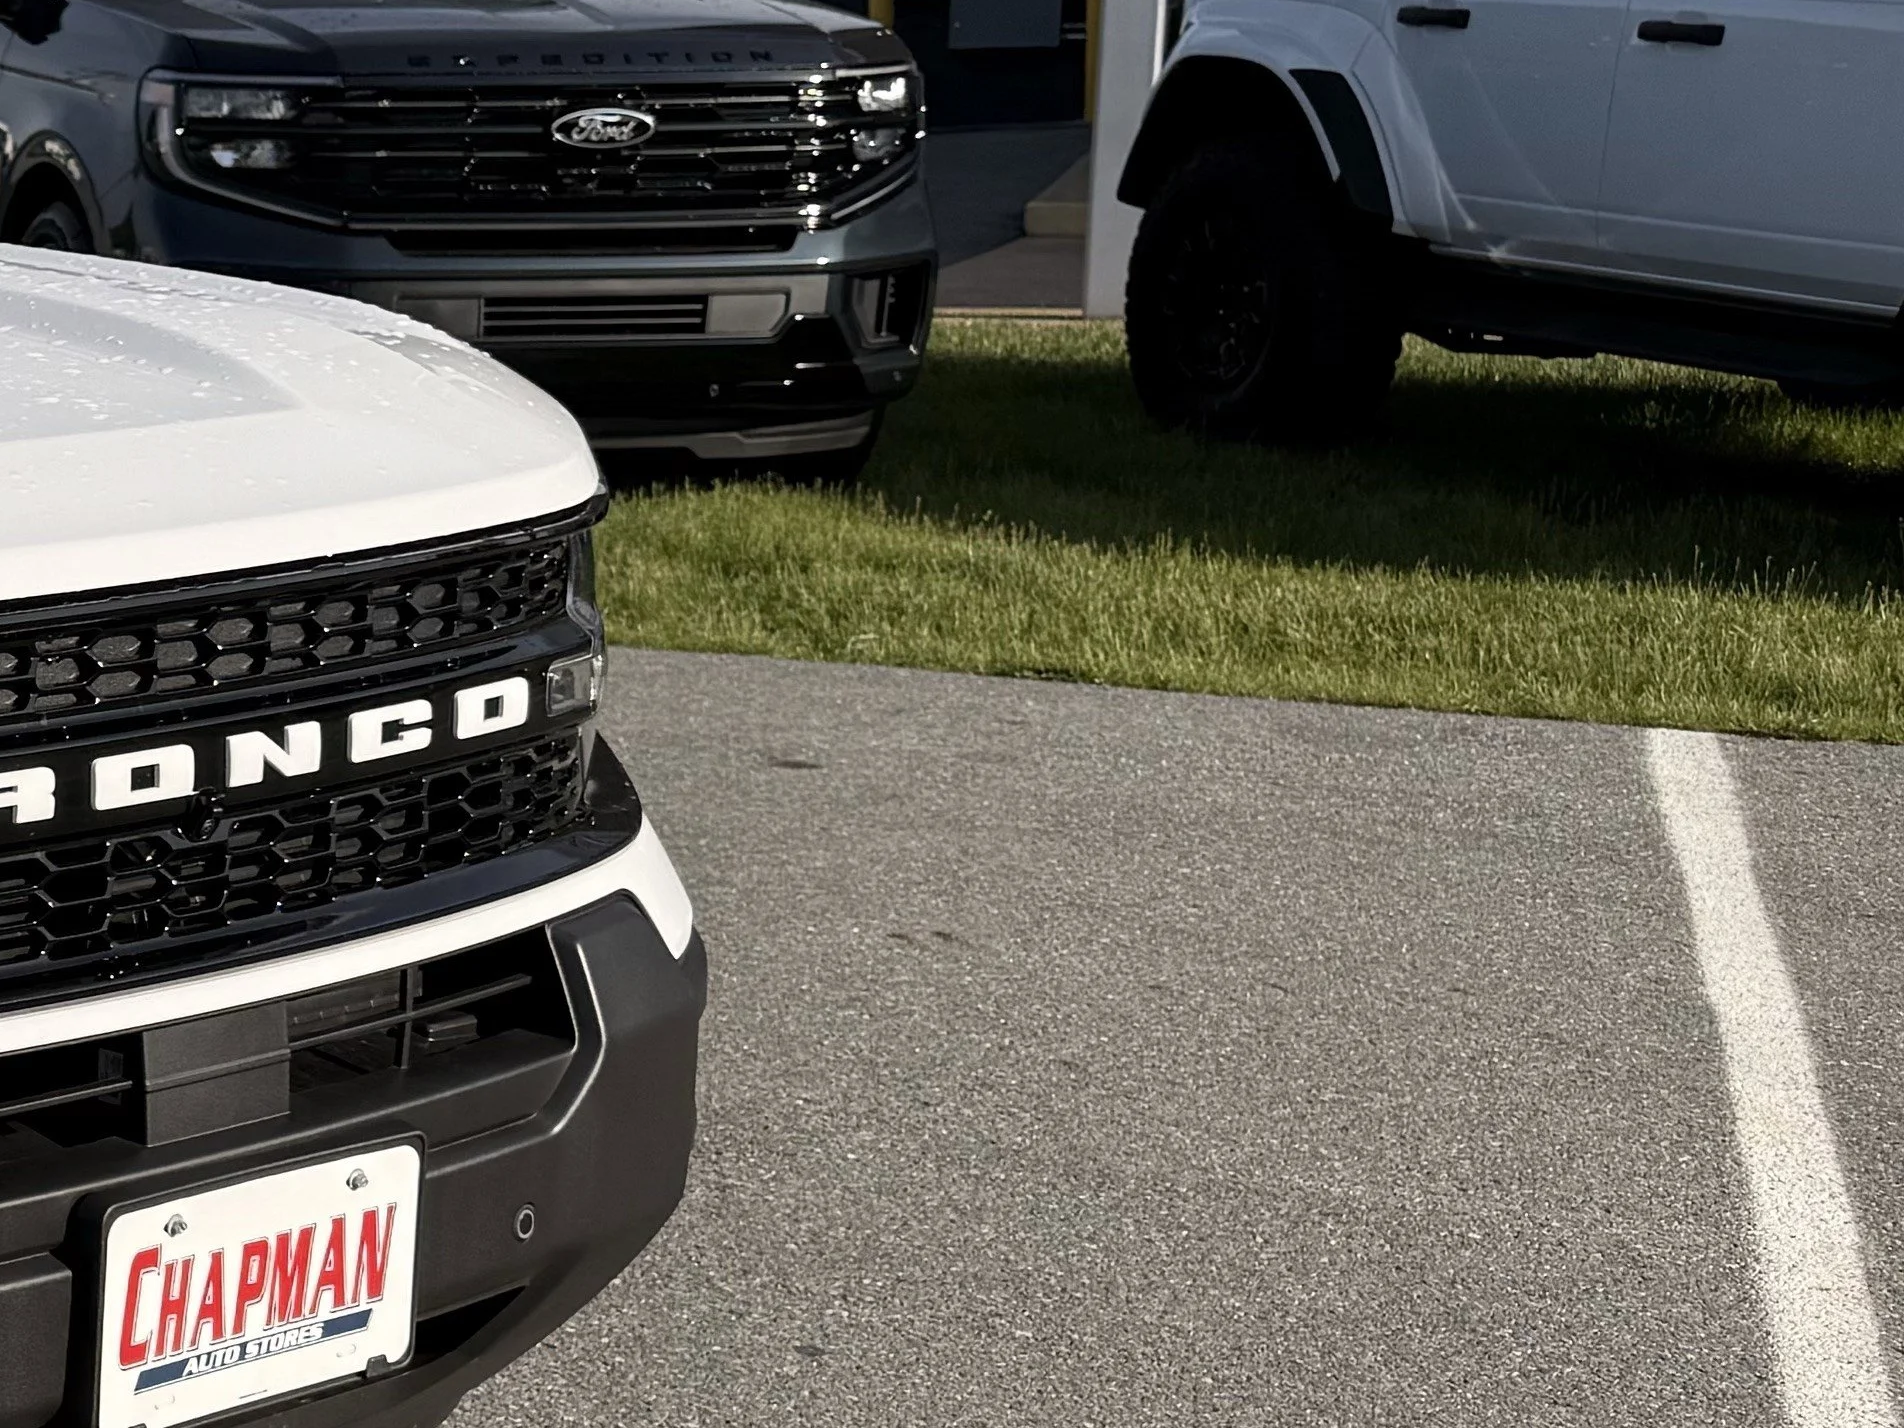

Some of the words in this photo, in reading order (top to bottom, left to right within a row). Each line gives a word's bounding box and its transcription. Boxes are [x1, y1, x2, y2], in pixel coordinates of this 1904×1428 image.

[570, 114, 636, 143] Ford
[118, 1203, 397, 1369] CHAPMAN
[182, 1343, 237, 1377] AUTO
[244, 1322, 324, 1363] STORES
